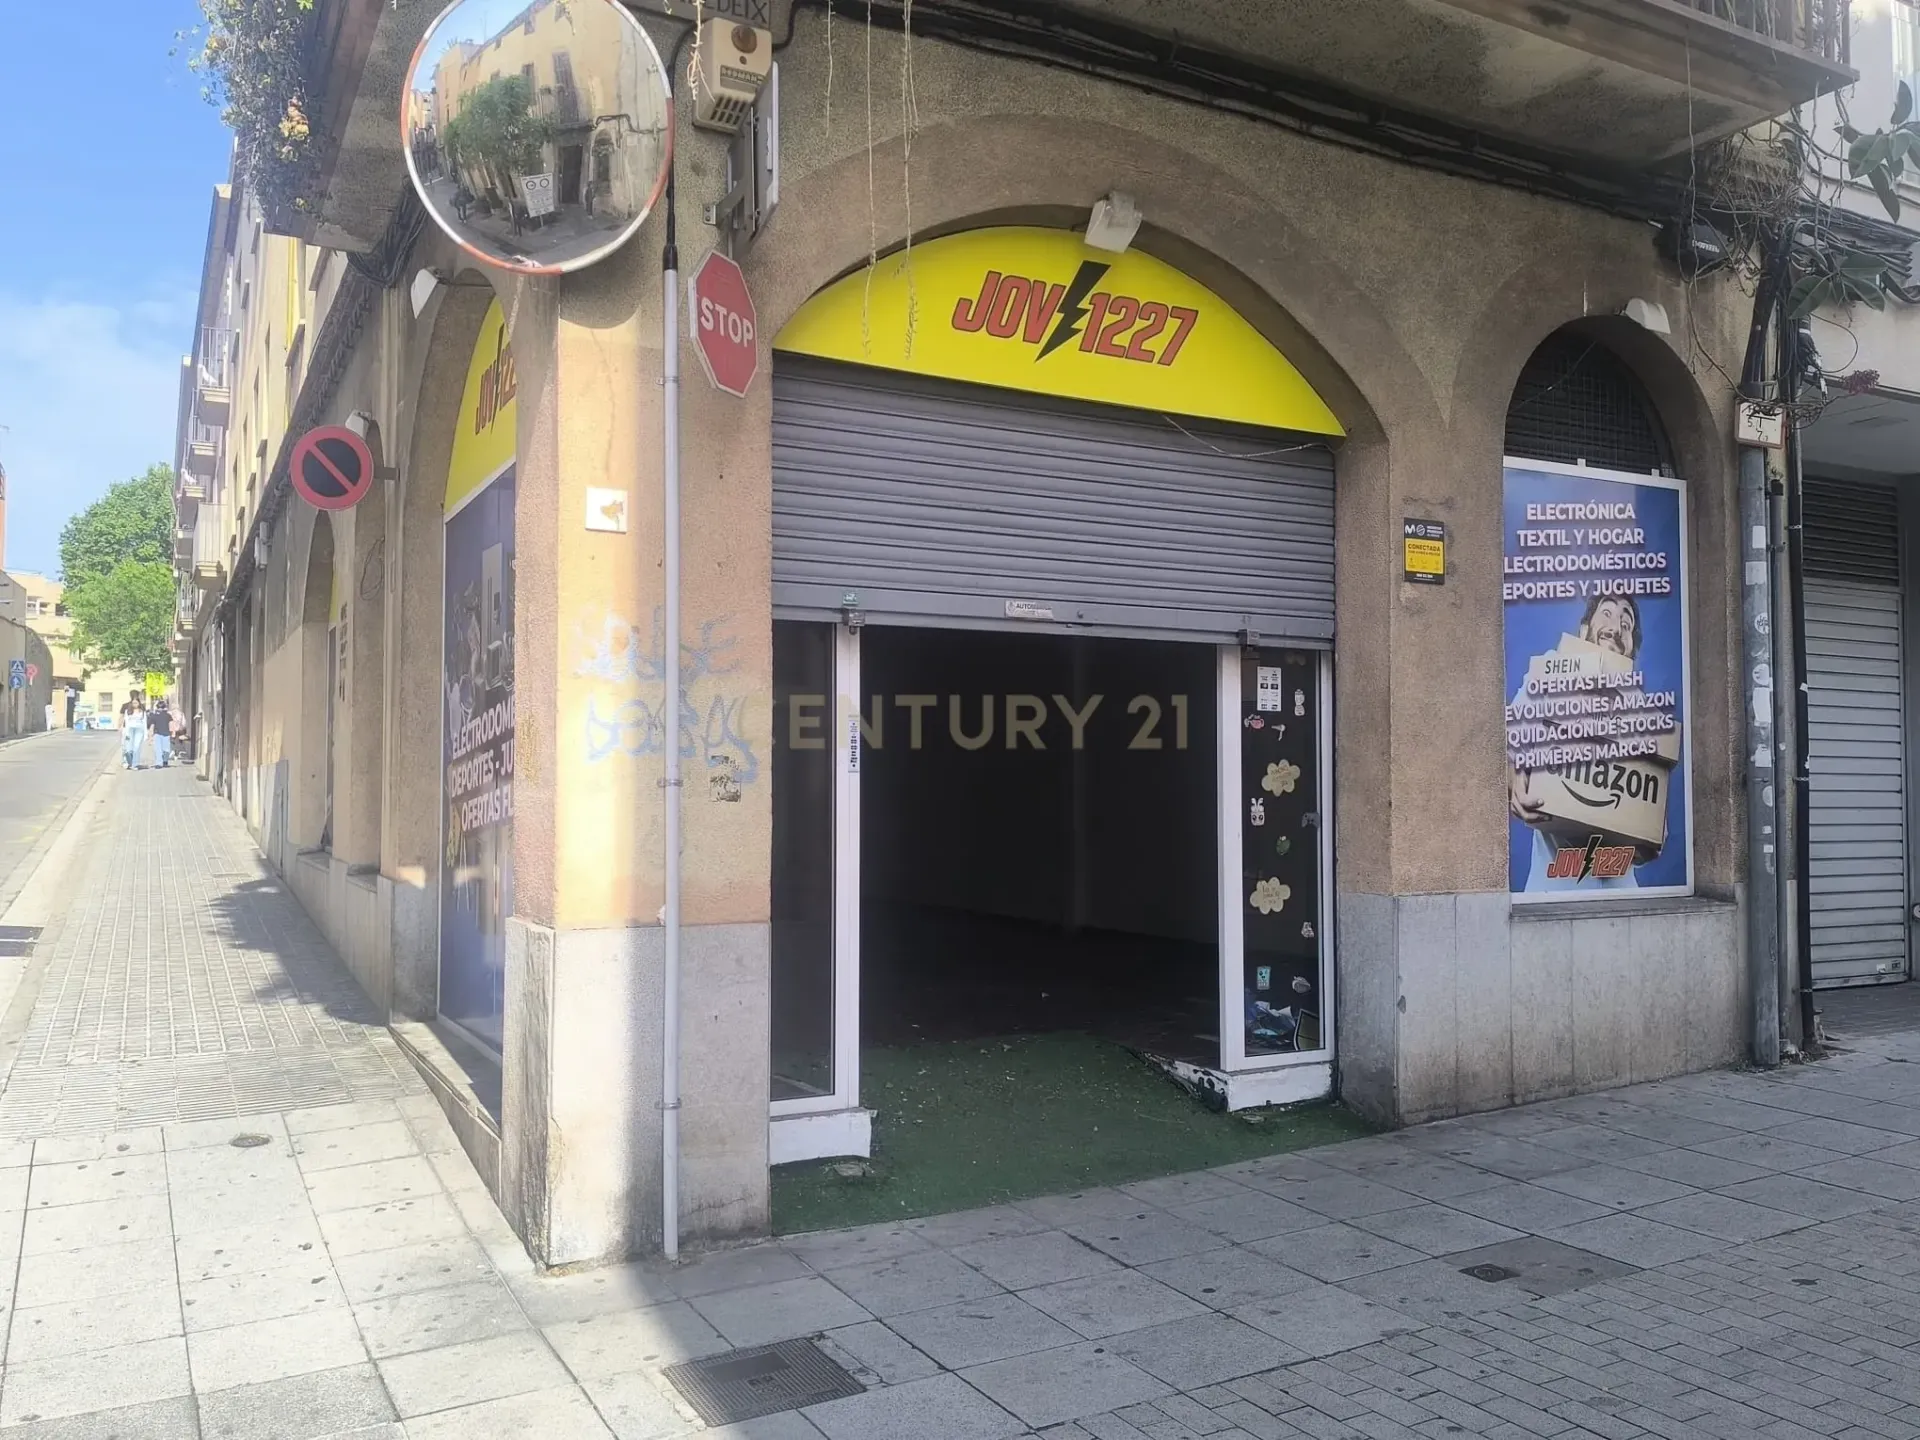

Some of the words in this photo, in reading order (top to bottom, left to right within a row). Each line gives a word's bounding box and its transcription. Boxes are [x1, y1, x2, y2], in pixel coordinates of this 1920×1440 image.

[700, 299, 753, 347] STOP
[1079, 292, 1198, 366] 1227
[1527, 500, 1636, 521] ELECTRÓNICA
[1517, 529, 1571, 547] TEXTIL
[1574, 529, 1585, 546] Y
[1588, 528, 1644, 545] HOGAR
[1504, 550, 1667, 573] LECTRODOMÉSTICOS
[1503, 580, 1576, 600] EPORTES
[1579, 581, 1589, 596] Y
[1593, 577, 1671, 596] JUGUETES
[1545, 658, 1580, 674] SHEIN
[1527, 676, 1594, 694] OFERTAS
[1598, 671, 1643, 688] FLASH
[1506, 697, 1609, 721] EVOLUCIONES
[1613, 692, 1675, 711] AMAZON
[1598, 719, 1617, 736] DE
[1621, 714, 1674, 734] STOCKS
[1515, 745, 1592, 769] PRIMERAS
[1596, 739, 1657, 760] MARCAS
[452, 749, 494, 798] DEPORTES
[462, 789, 500, 832] OFERTAS
[1591, 846, 1636, 878] 1227
